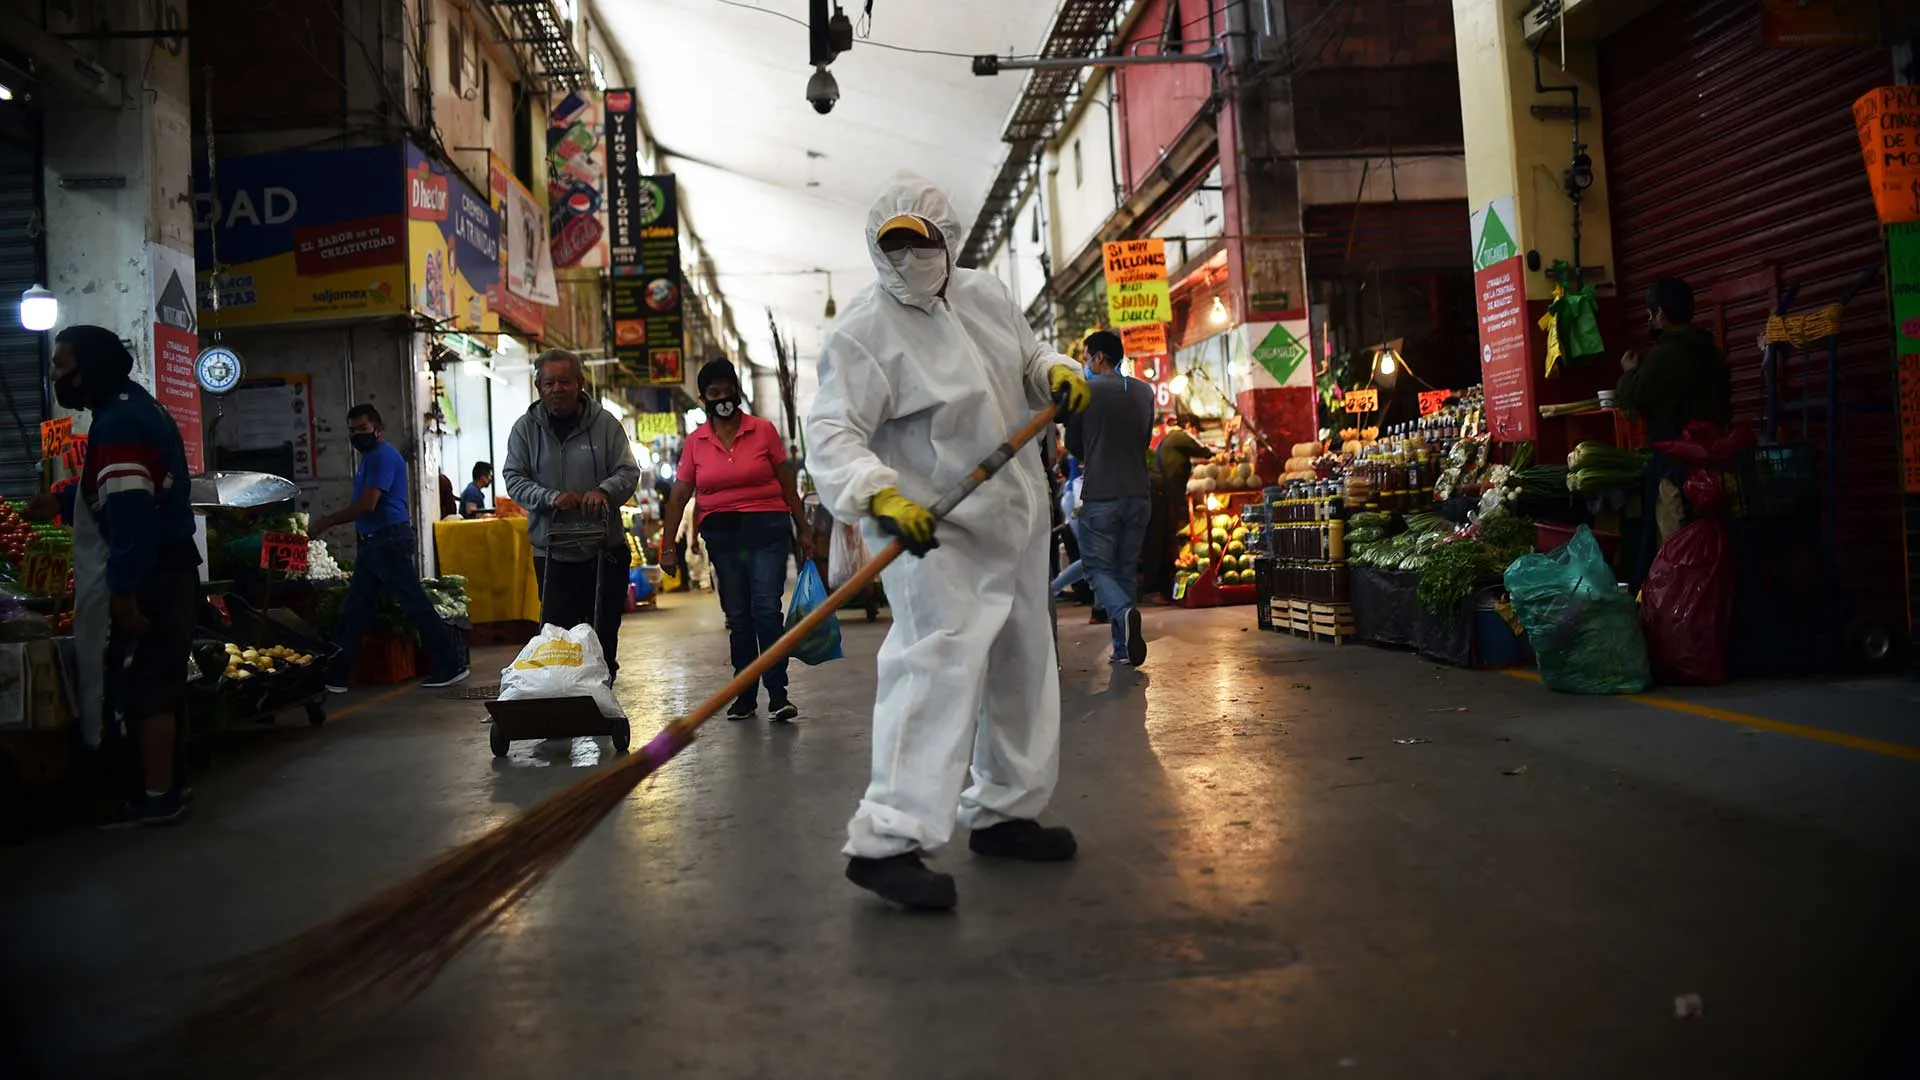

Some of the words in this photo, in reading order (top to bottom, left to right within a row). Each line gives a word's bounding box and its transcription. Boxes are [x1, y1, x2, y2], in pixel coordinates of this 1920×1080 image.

[317, 231, 353, 248] SABOR
[320, 235, 395, 259] CREATIVIDAD
[1109, 253, 1166, 271] MELONES
